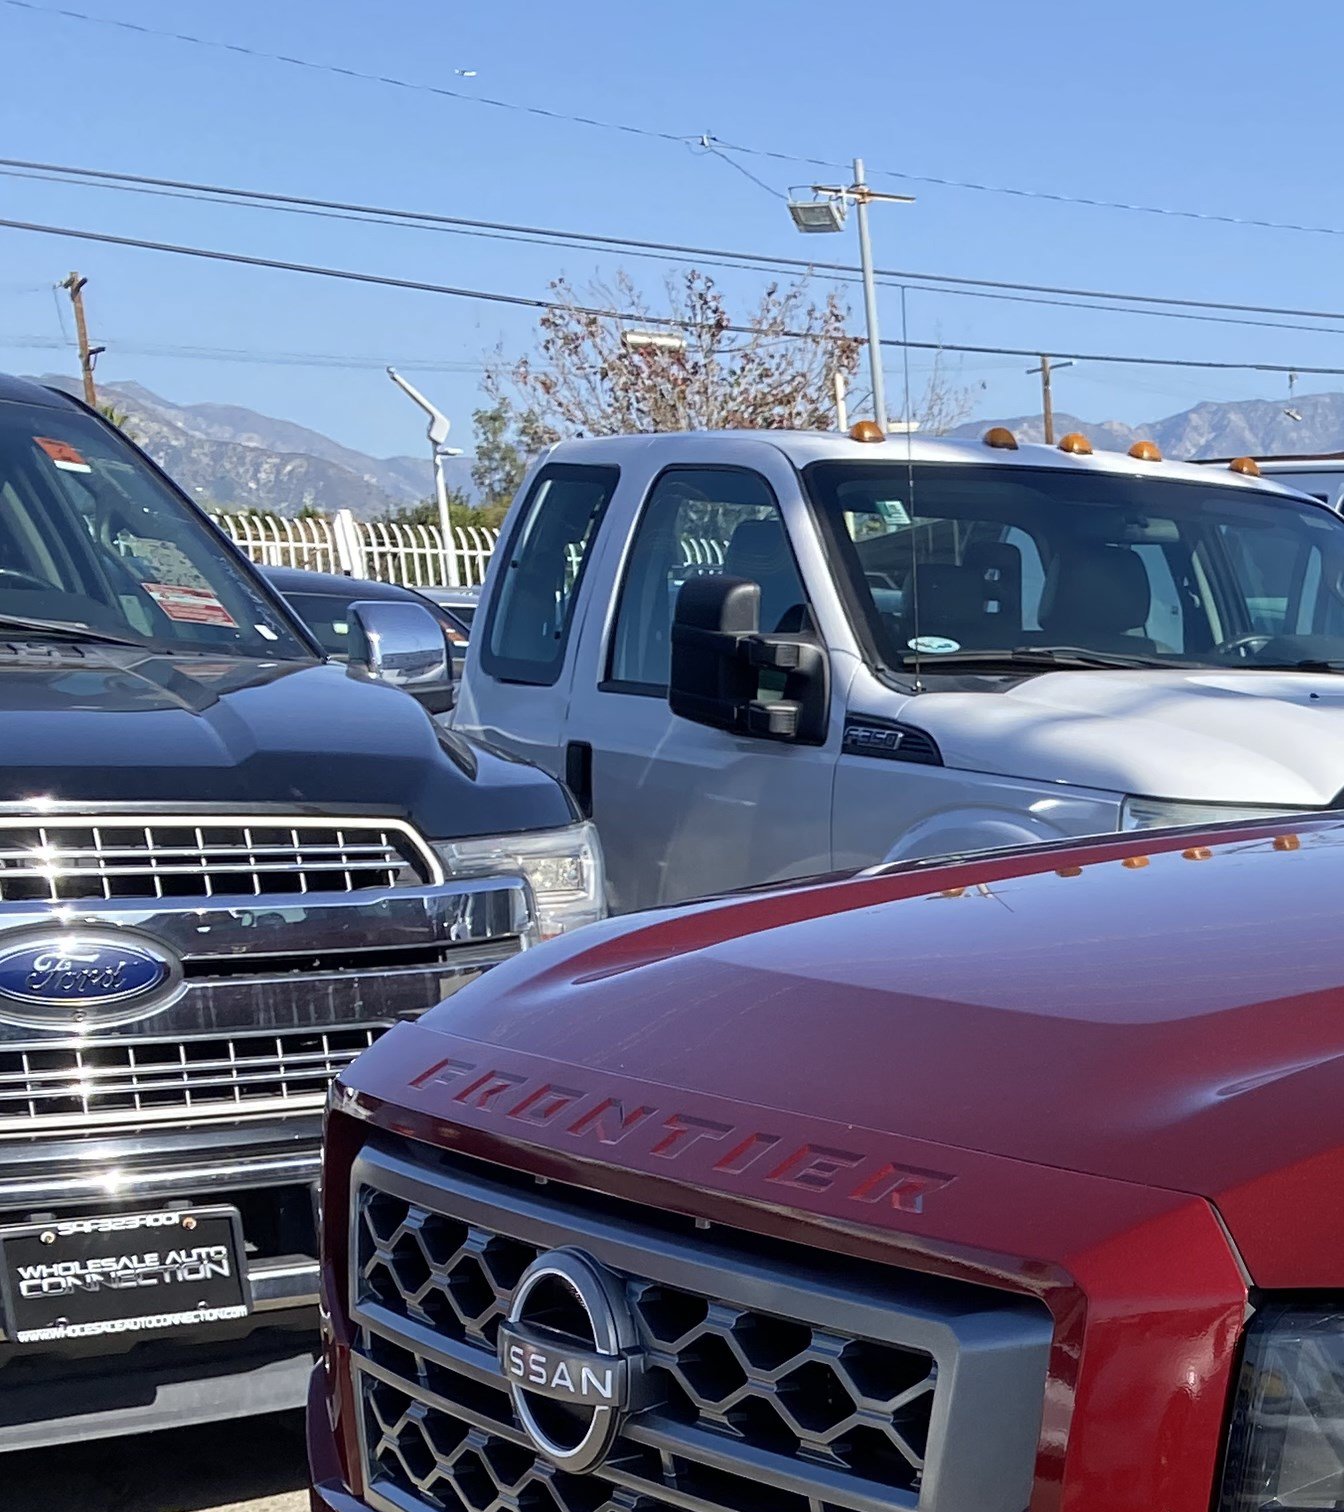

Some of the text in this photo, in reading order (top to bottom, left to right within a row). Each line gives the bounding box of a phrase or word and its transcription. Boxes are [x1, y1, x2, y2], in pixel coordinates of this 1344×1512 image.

[26, 951, 126, 993] Ford
[407, 1057, 958, 1214] FRONTIER
[17, 1245, 228, 1280] WHOLESALE AUTO
[19, 1260, 231, 1299] CONNECTION
